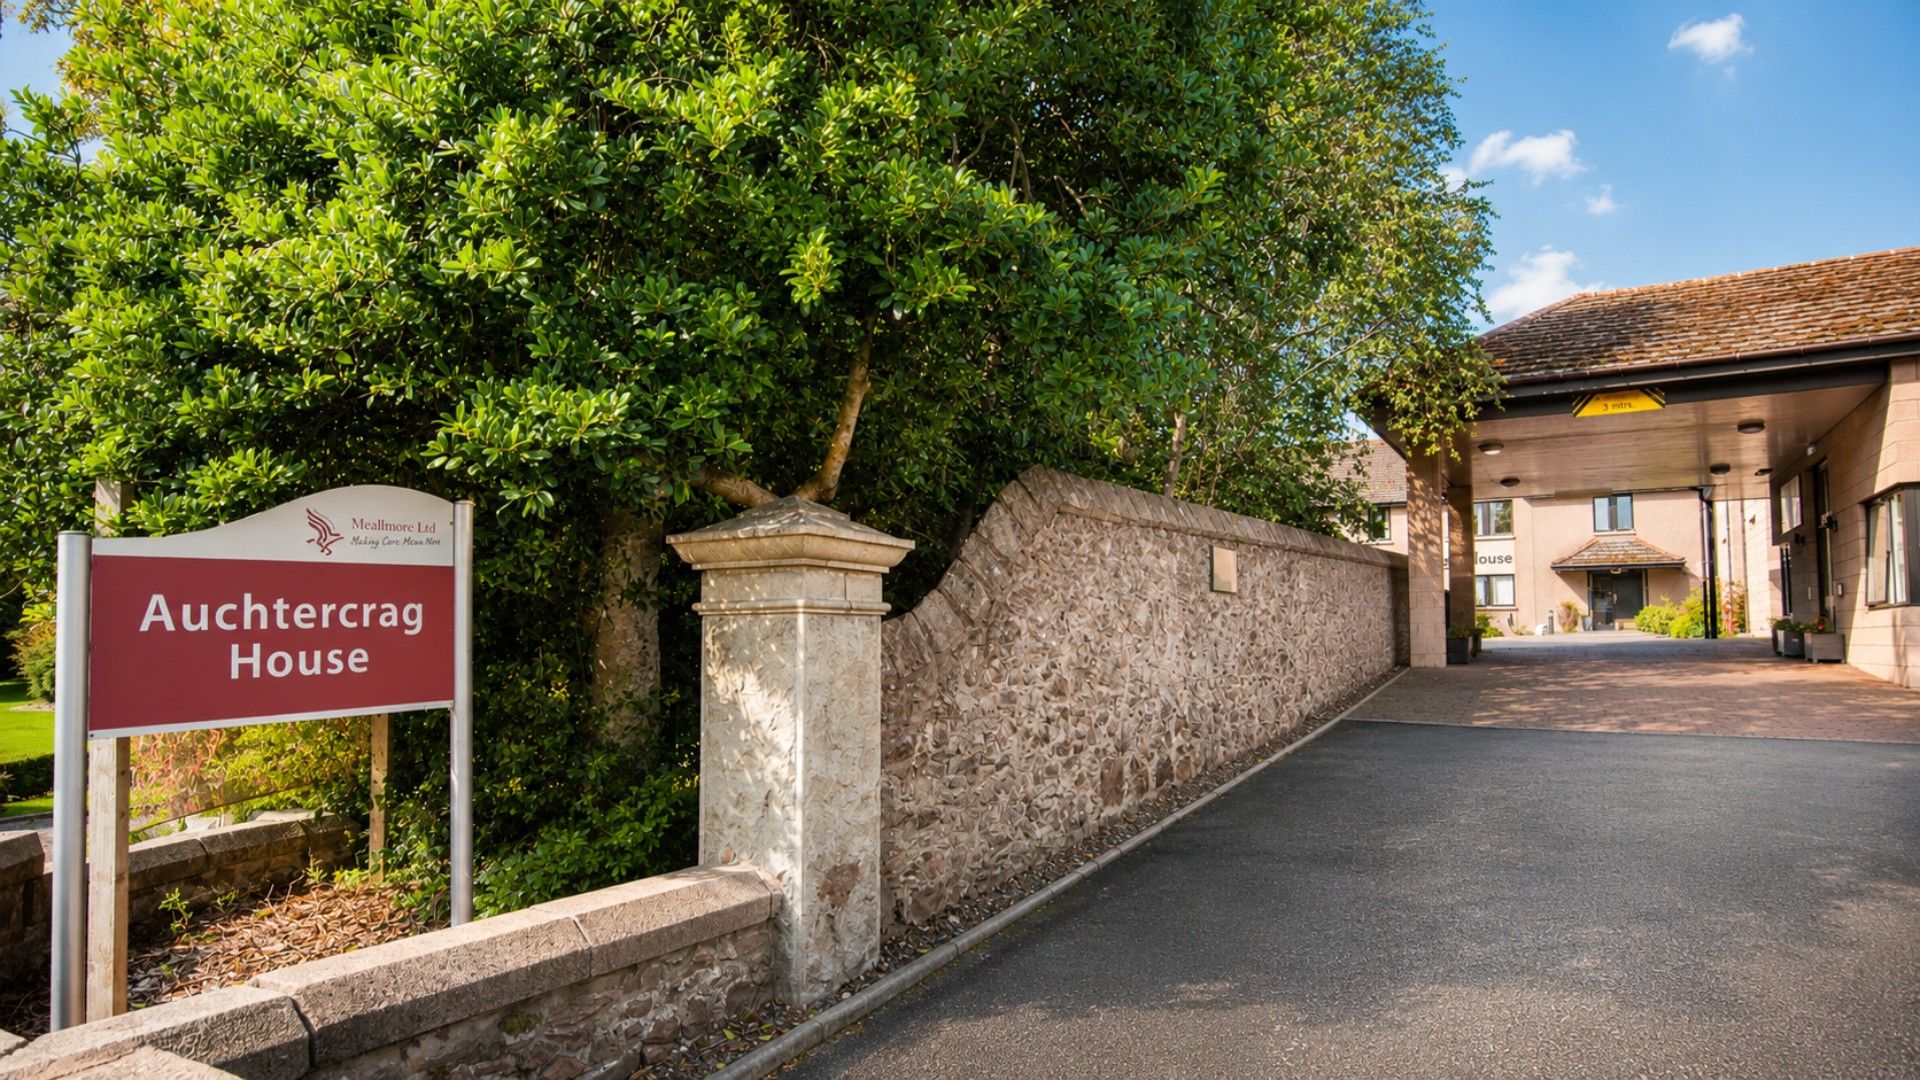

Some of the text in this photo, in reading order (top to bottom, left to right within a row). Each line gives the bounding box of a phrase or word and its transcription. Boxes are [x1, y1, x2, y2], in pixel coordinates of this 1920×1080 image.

[1602, 403, 1609, 411] 3
[352, 517, 436, 533] Meallmore Ltd
[350, 536, 380, 549] Making
[139, 592, 424, 636] Auchtercrag
[230, 642, 370, 680] House
